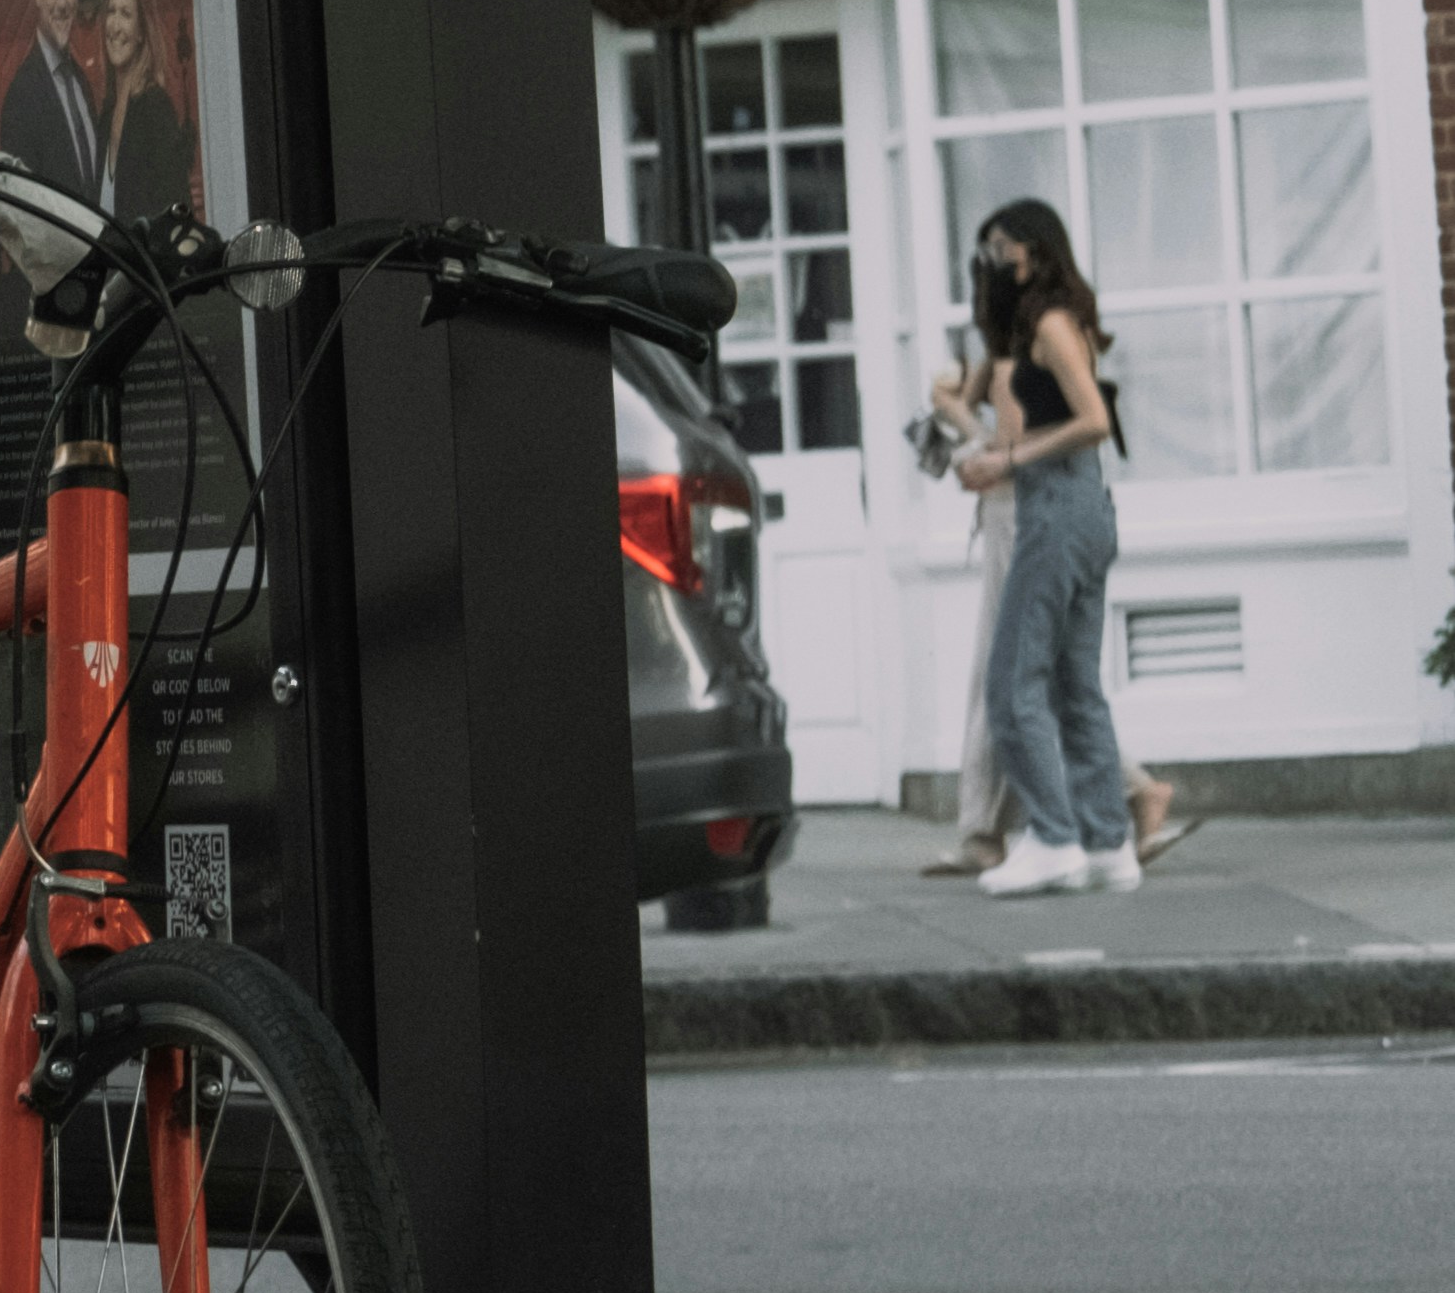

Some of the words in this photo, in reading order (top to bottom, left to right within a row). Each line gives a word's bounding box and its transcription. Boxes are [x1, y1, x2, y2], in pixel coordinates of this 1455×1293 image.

[167, 648, 193, 664] SCAN
[169, 679, 189, 695] COD
[197, 678, 230, 694] BELOW
[162, 709, 175, 725] TO
[206, 707, 224, 723] THE
[197, 738, 232, 754] BEHIND
